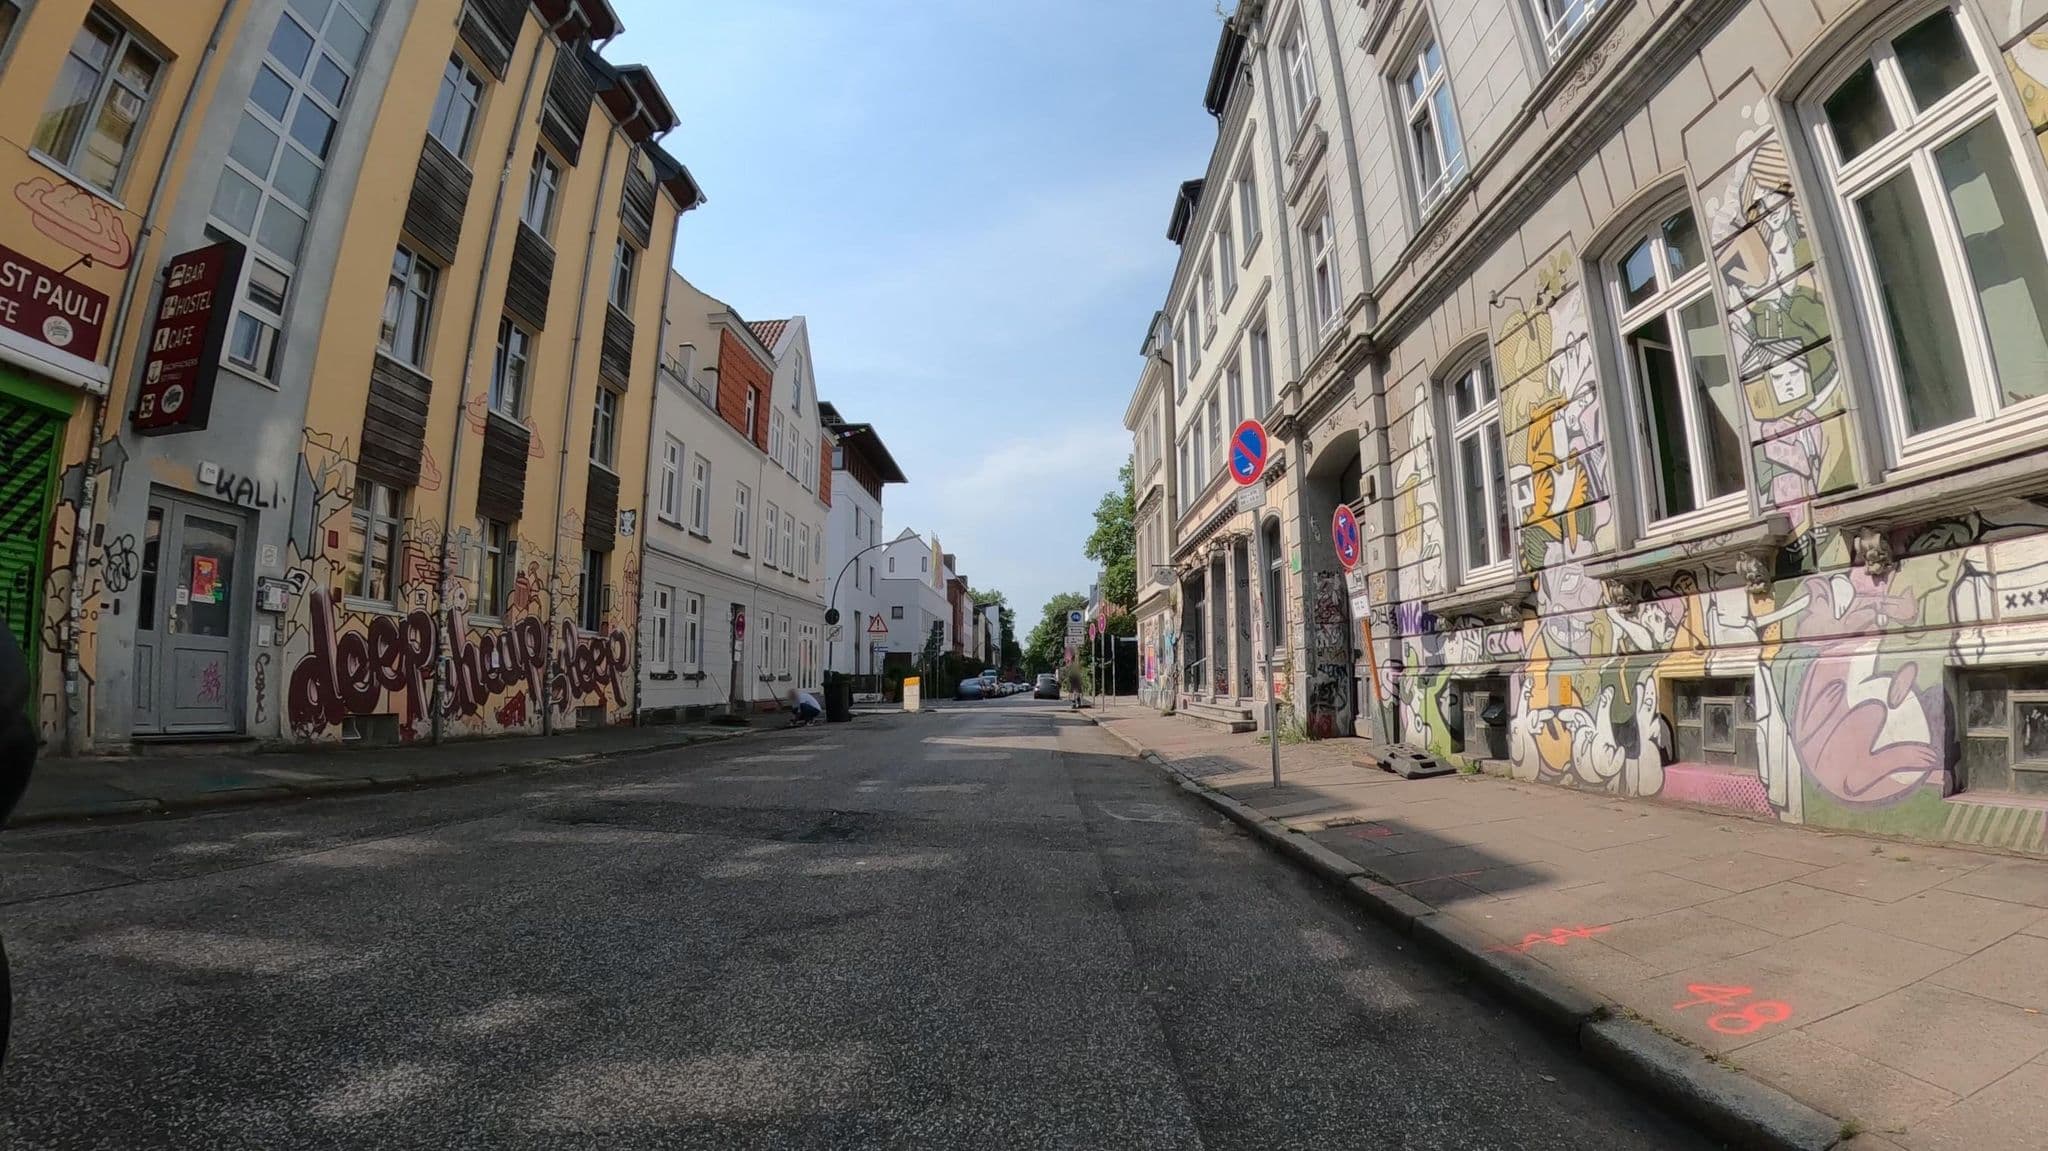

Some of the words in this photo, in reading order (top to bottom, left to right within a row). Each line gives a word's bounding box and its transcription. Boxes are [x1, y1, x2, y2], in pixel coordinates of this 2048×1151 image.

[0, 261, 32, 292] ST
[33, 275, 101, 326] PAULI
[183, 262, 206, 285] BAR
[175, 290, 212, 316] HOSTEL
[288, 585, 437, 736] deep
